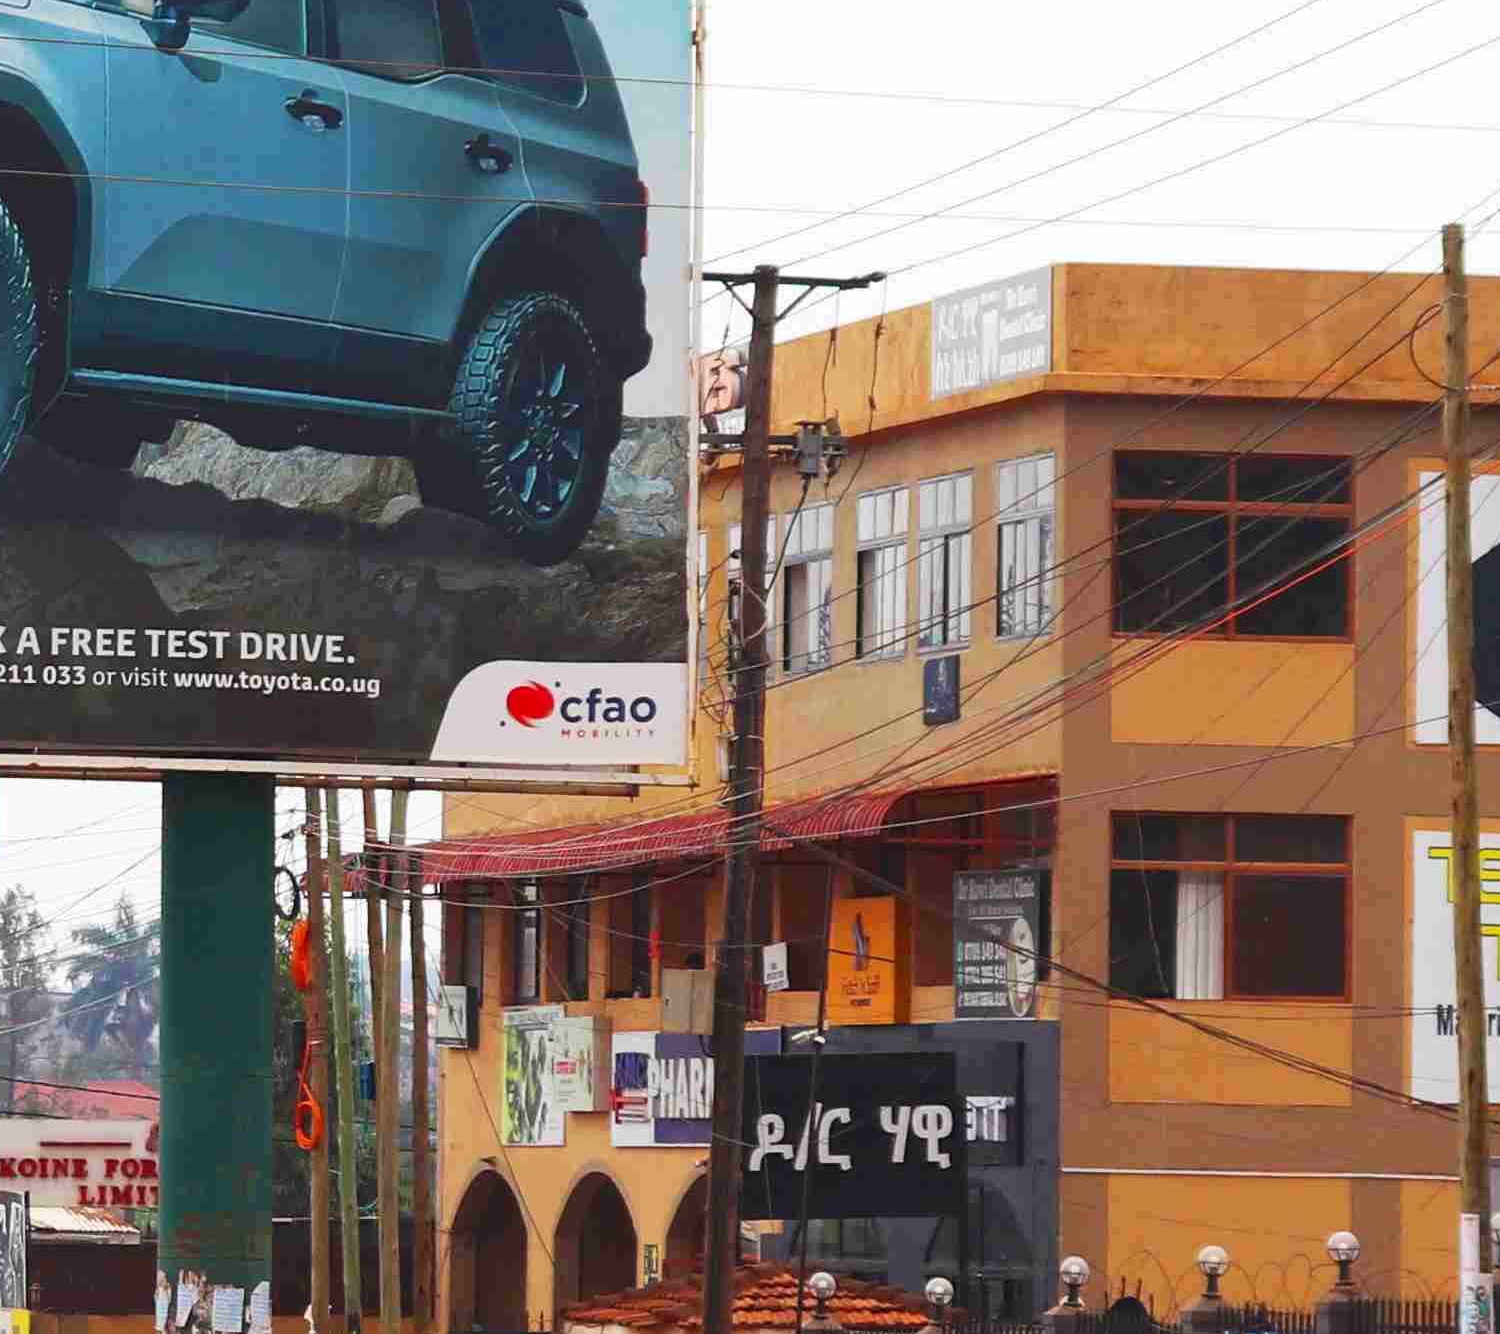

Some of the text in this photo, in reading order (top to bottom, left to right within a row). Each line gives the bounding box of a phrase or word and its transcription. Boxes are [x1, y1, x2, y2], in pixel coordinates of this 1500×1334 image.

[16, 627, 40, 655] A
[50, 627, 137, 658] FREE
[144, 630, 230, 659] TEST
[239, 633, 355, 665] DRIVE.
[42, 665, 86, 687] 033
[92, 669, 116, 686] or
[121, 666, 168, 688] visit
[174, 669, 381, 698] www.toyota.co.ug
[560, 688, 657, 723] cfao
[561, 729, 655, 738] MOBILITY
